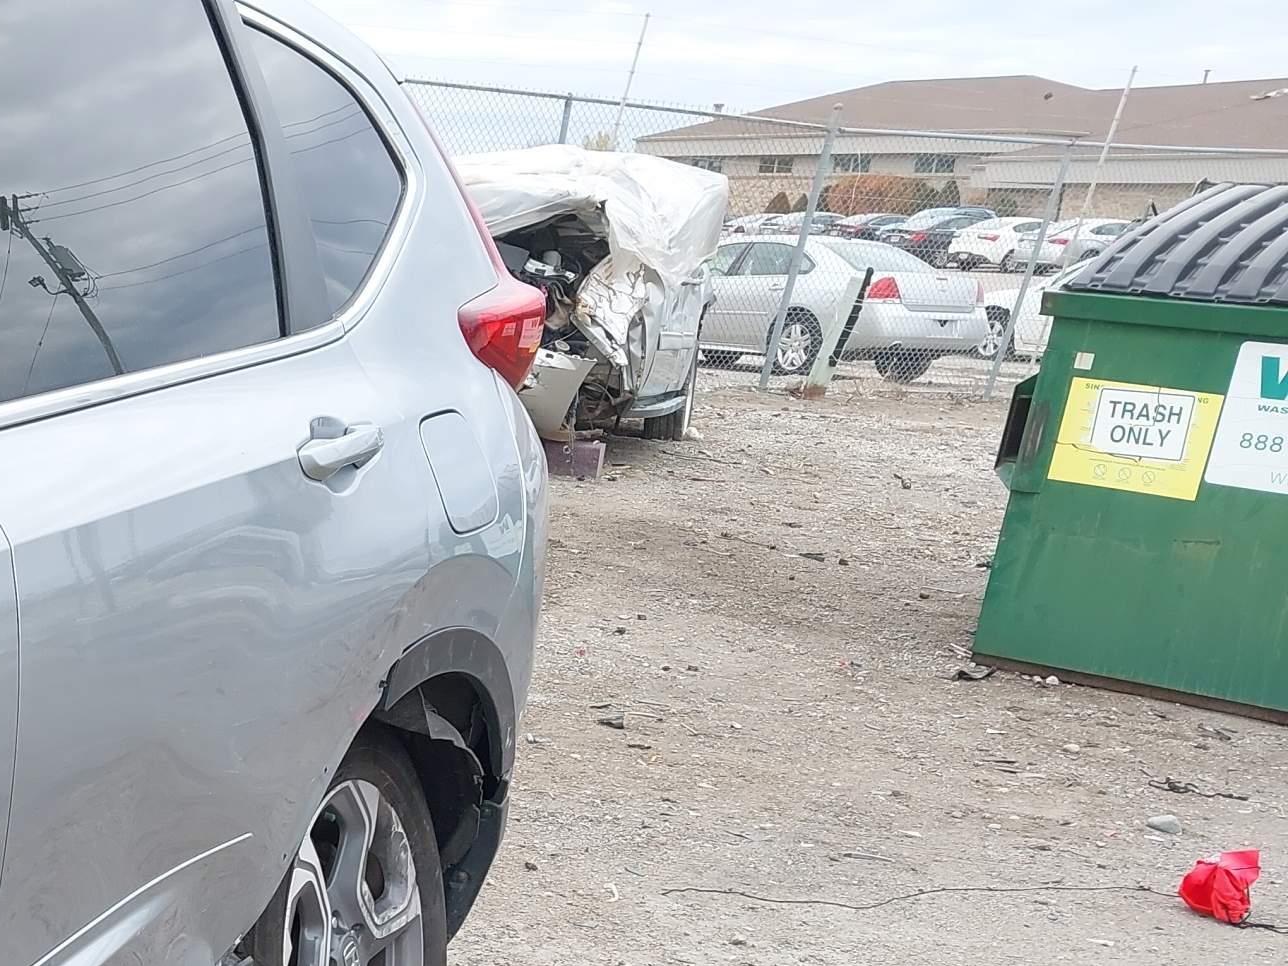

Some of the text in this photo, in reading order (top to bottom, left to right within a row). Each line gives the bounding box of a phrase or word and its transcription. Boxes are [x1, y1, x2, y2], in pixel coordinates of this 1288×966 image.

[1109, 400, 1183, 424] TRASH
[1110, 424, 1171, 447] ONLY
[1239, 432, 1284, 453] 888
